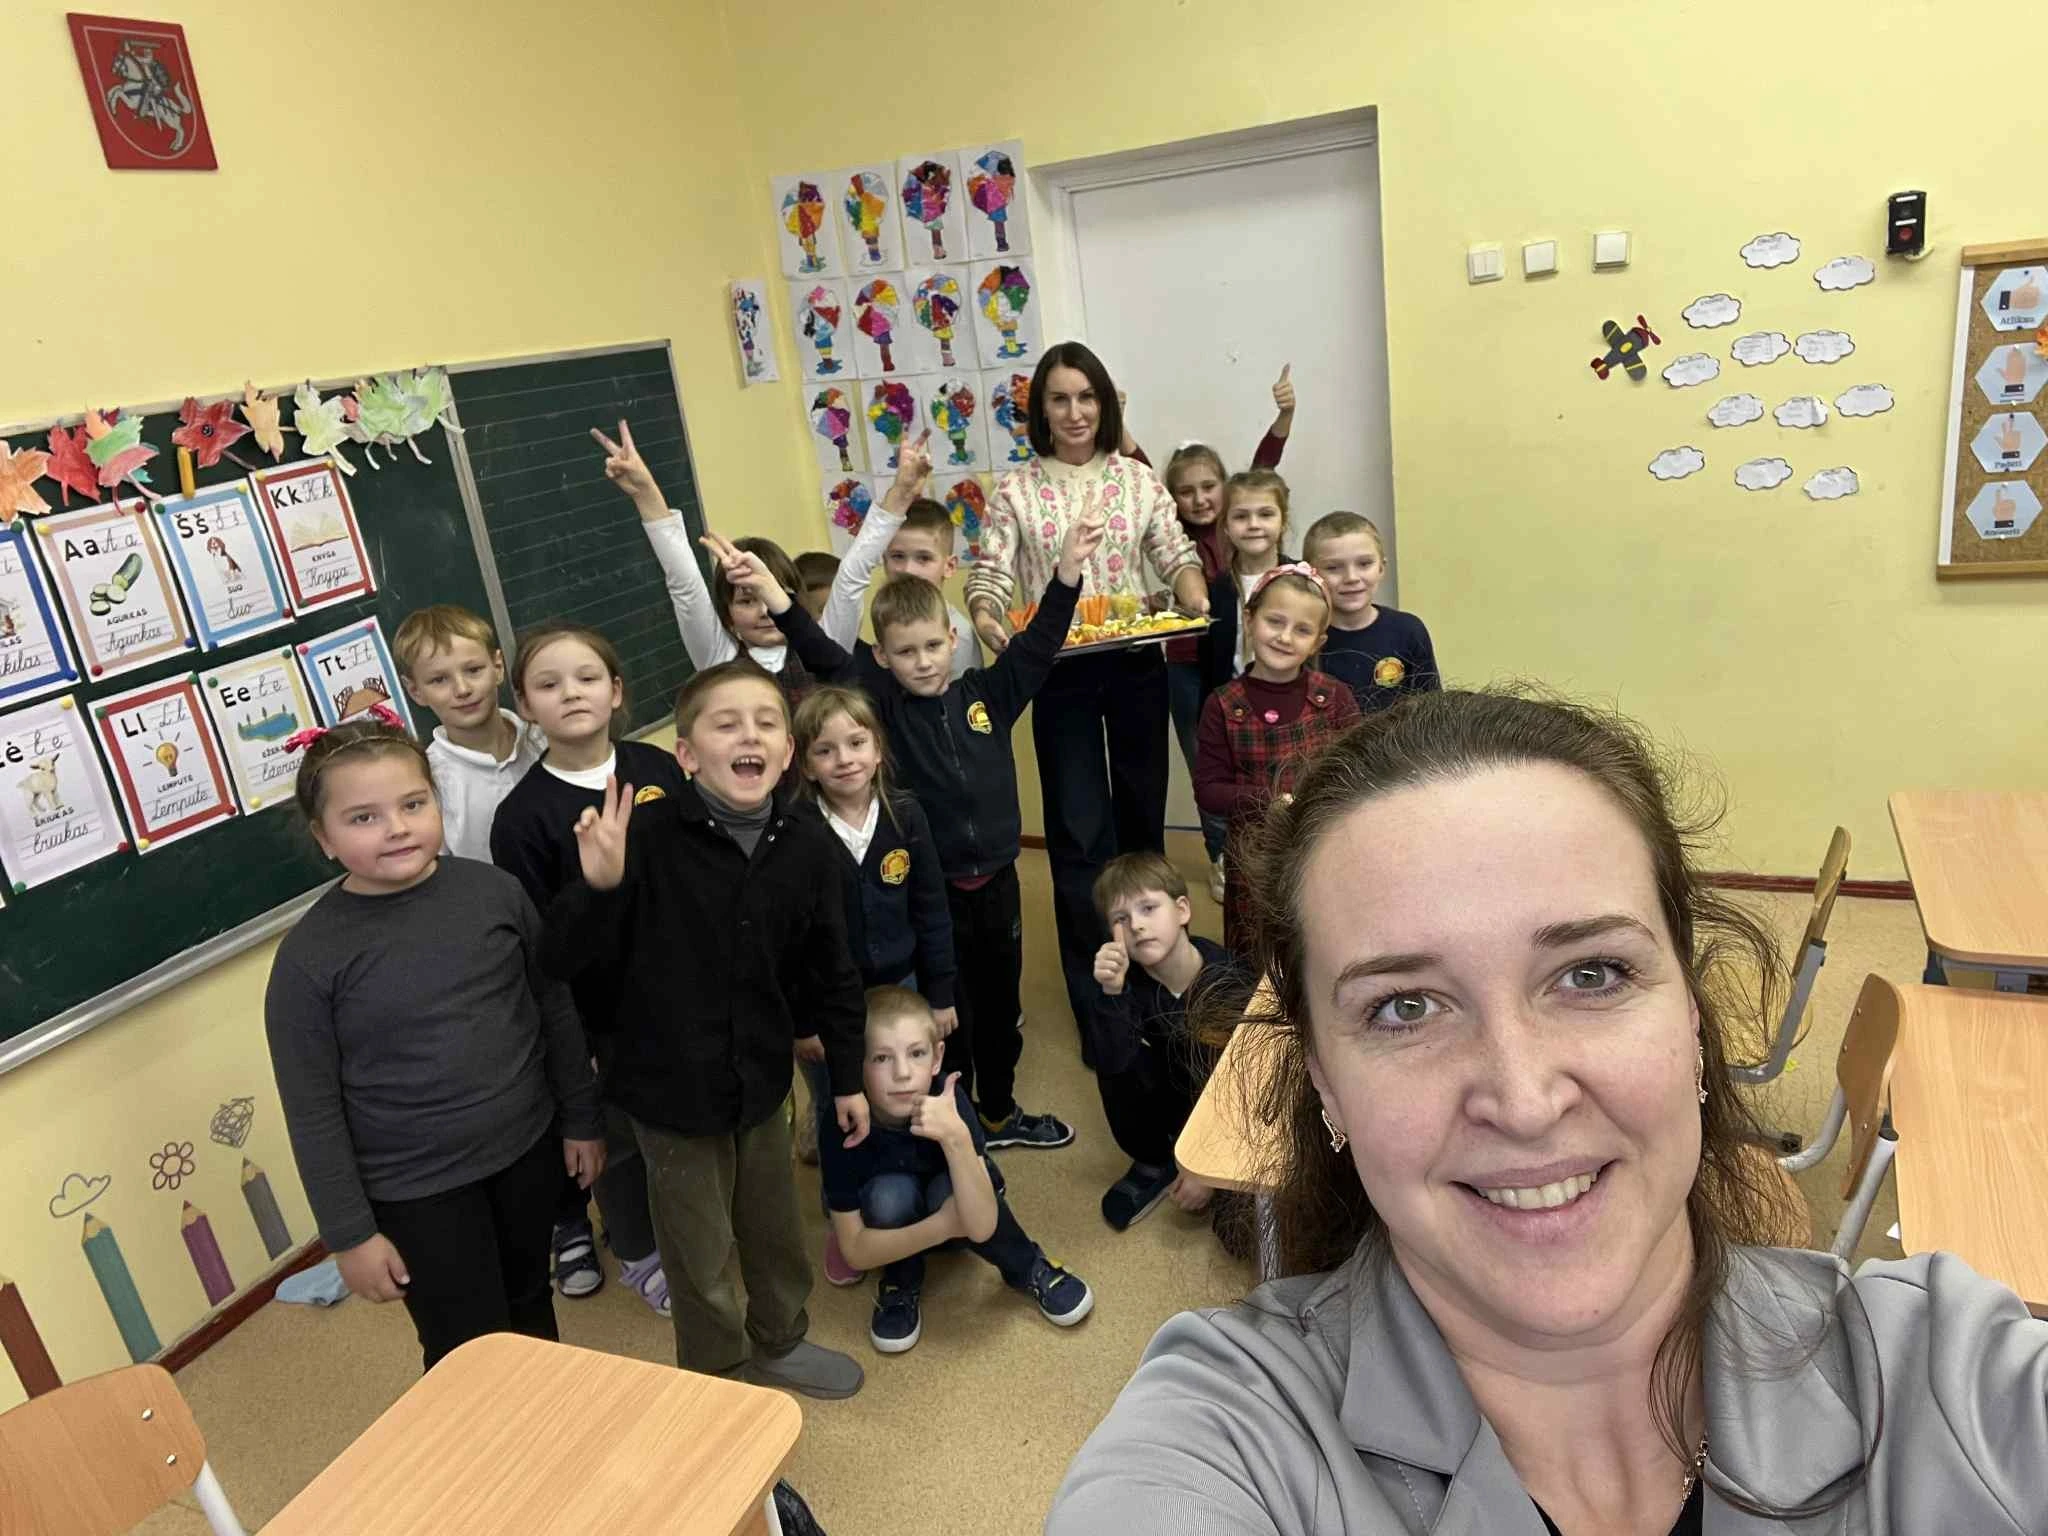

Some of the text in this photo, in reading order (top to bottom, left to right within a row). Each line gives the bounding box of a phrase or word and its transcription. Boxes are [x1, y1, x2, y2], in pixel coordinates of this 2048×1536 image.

[270, 485, 302, 509] Kk
[174, 513, 209, 538] Šš
[65, 538, 100, 561] Aa
[305, 566, 349, 589] Knyga
[107, 608, 148, 626] AGURKAS
[105, 623, 161, 657] Agurkas
[318, 656, 347, 676] Tt
[219, 687, 251, 709] Ee
[120, 712, 147, 738] Ll
[0, 741, 24, 768] ė
